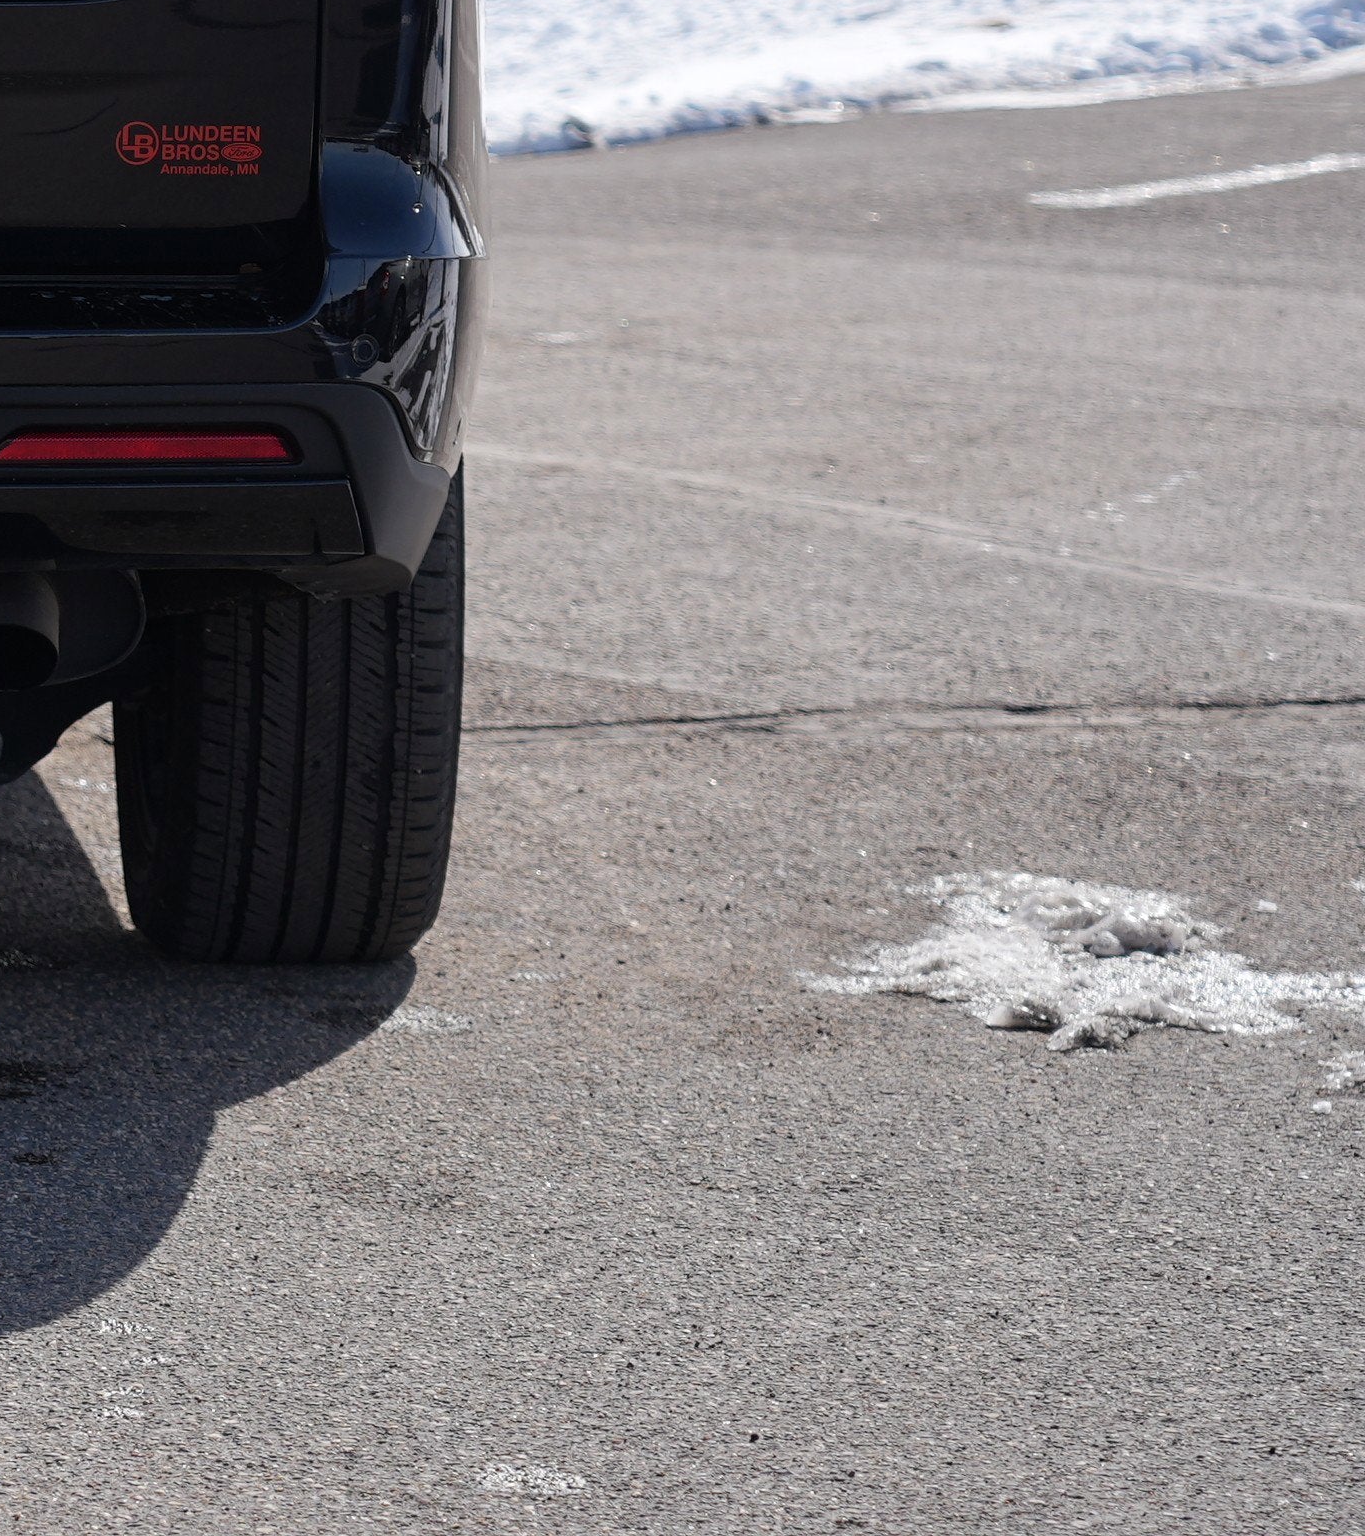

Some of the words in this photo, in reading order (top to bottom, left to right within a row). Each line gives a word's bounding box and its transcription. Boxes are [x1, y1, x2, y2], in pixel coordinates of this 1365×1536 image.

[161, 125, 262, 142] LUNDEEN
[161, 144, 221, 161] BROS
[228, 146, 255, 158] Ford
[160, 164, 235, 177] Annandale,
[237, 164, 260, 176] MN
